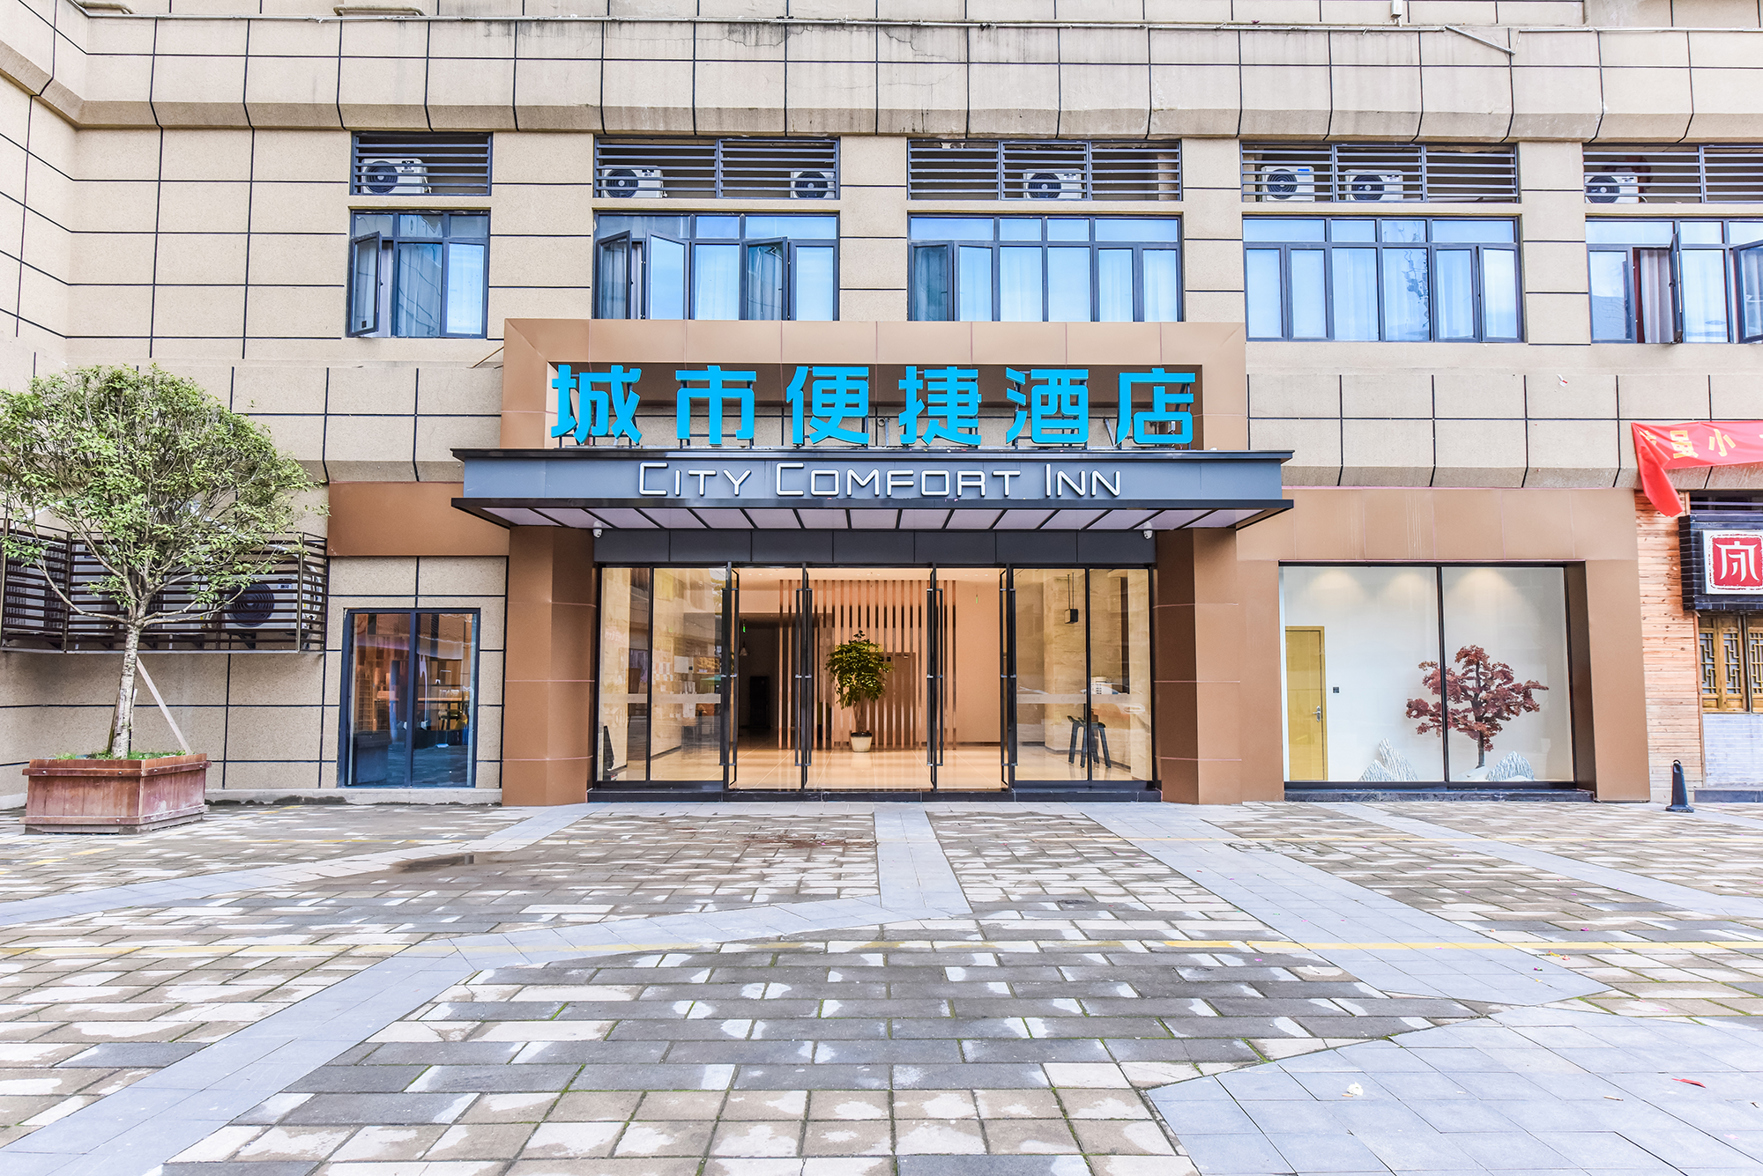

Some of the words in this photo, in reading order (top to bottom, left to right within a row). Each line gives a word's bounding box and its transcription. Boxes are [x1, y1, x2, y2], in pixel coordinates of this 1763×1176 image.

[551, 365, 1195, 446] 城市便捷酒店
[638, 461, 752, 497] CITY
[776, 461, 1021, 498] COMFORT
[1045, 461, 1121, 498] INN
